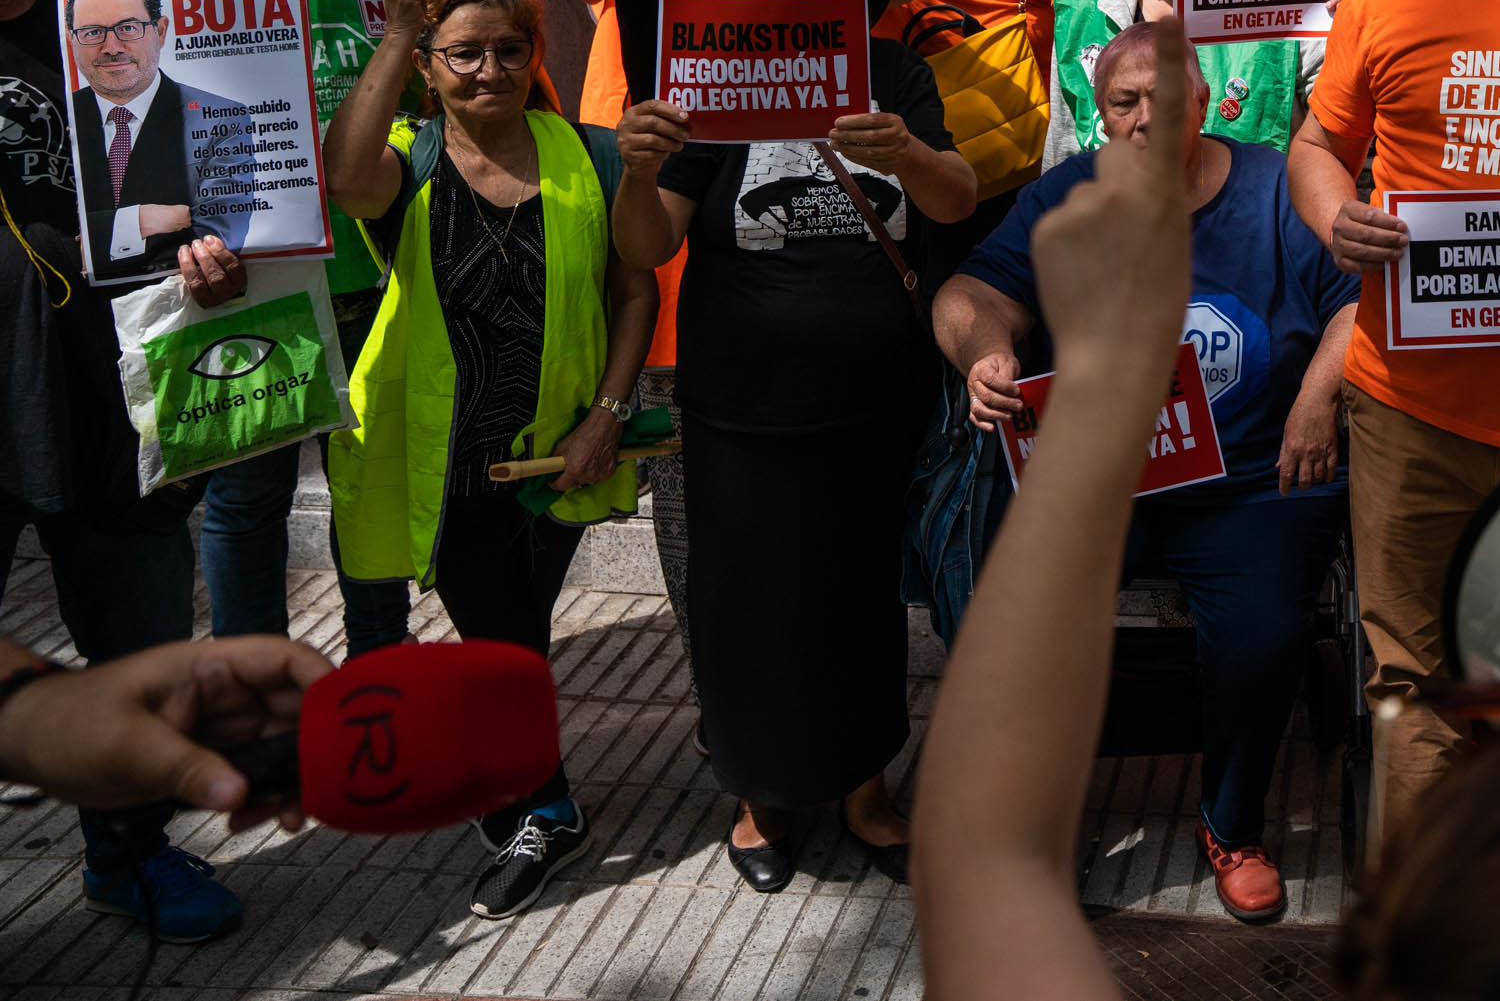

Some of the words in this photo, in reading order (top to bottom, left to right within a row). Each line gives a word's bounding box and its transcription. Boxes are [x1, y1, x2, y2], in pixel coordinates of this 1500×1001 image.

[1224, 13, 1245, 30] EN
[1246, 9, 1302, 28] GETAFE
[175, 37, 184, 51] A
[186, 34, 221, 50] JUAN
[223, 31, 264, 46] PABLO
[265, 28, 299, 43] VERA
[672, 21, 846, 52] BLACKSTONE
[175, 50, 212, 61] DIRECTOR
[212, 47, 246, 58] GENERAL
[246, 46, 255, 55] DE
[256, 44, 278, 54] TESTA
[278, 43, 300, 52] HOME
[669, 52, 827, 84] NEGOCIACIÓN
[1446, 85, 1480, 111] DE
[1446, 118, 1460, 142] E
[194, 146, 210, 160] de
[212, 145, 230, 158] los
[232, 140, 298, 158] alquileres.
[1442, 144, 1474, 172] DE
[806, 185, 840, 196] HEMOS
[200, 202, 228, 217] Solo
[229, 198, 273, 214] confía.
[794, 208, 815, 218] por
[819, 203, 856, 216] ENCIMA
[807, 213, 863, 227] NUESTRAS
[1416, 275, 1456, 296] POR
[1451, 308, 1477, 328] EN
[177, 391, 246, 424] óptica
[252, 371, 312, 397] orgaz
